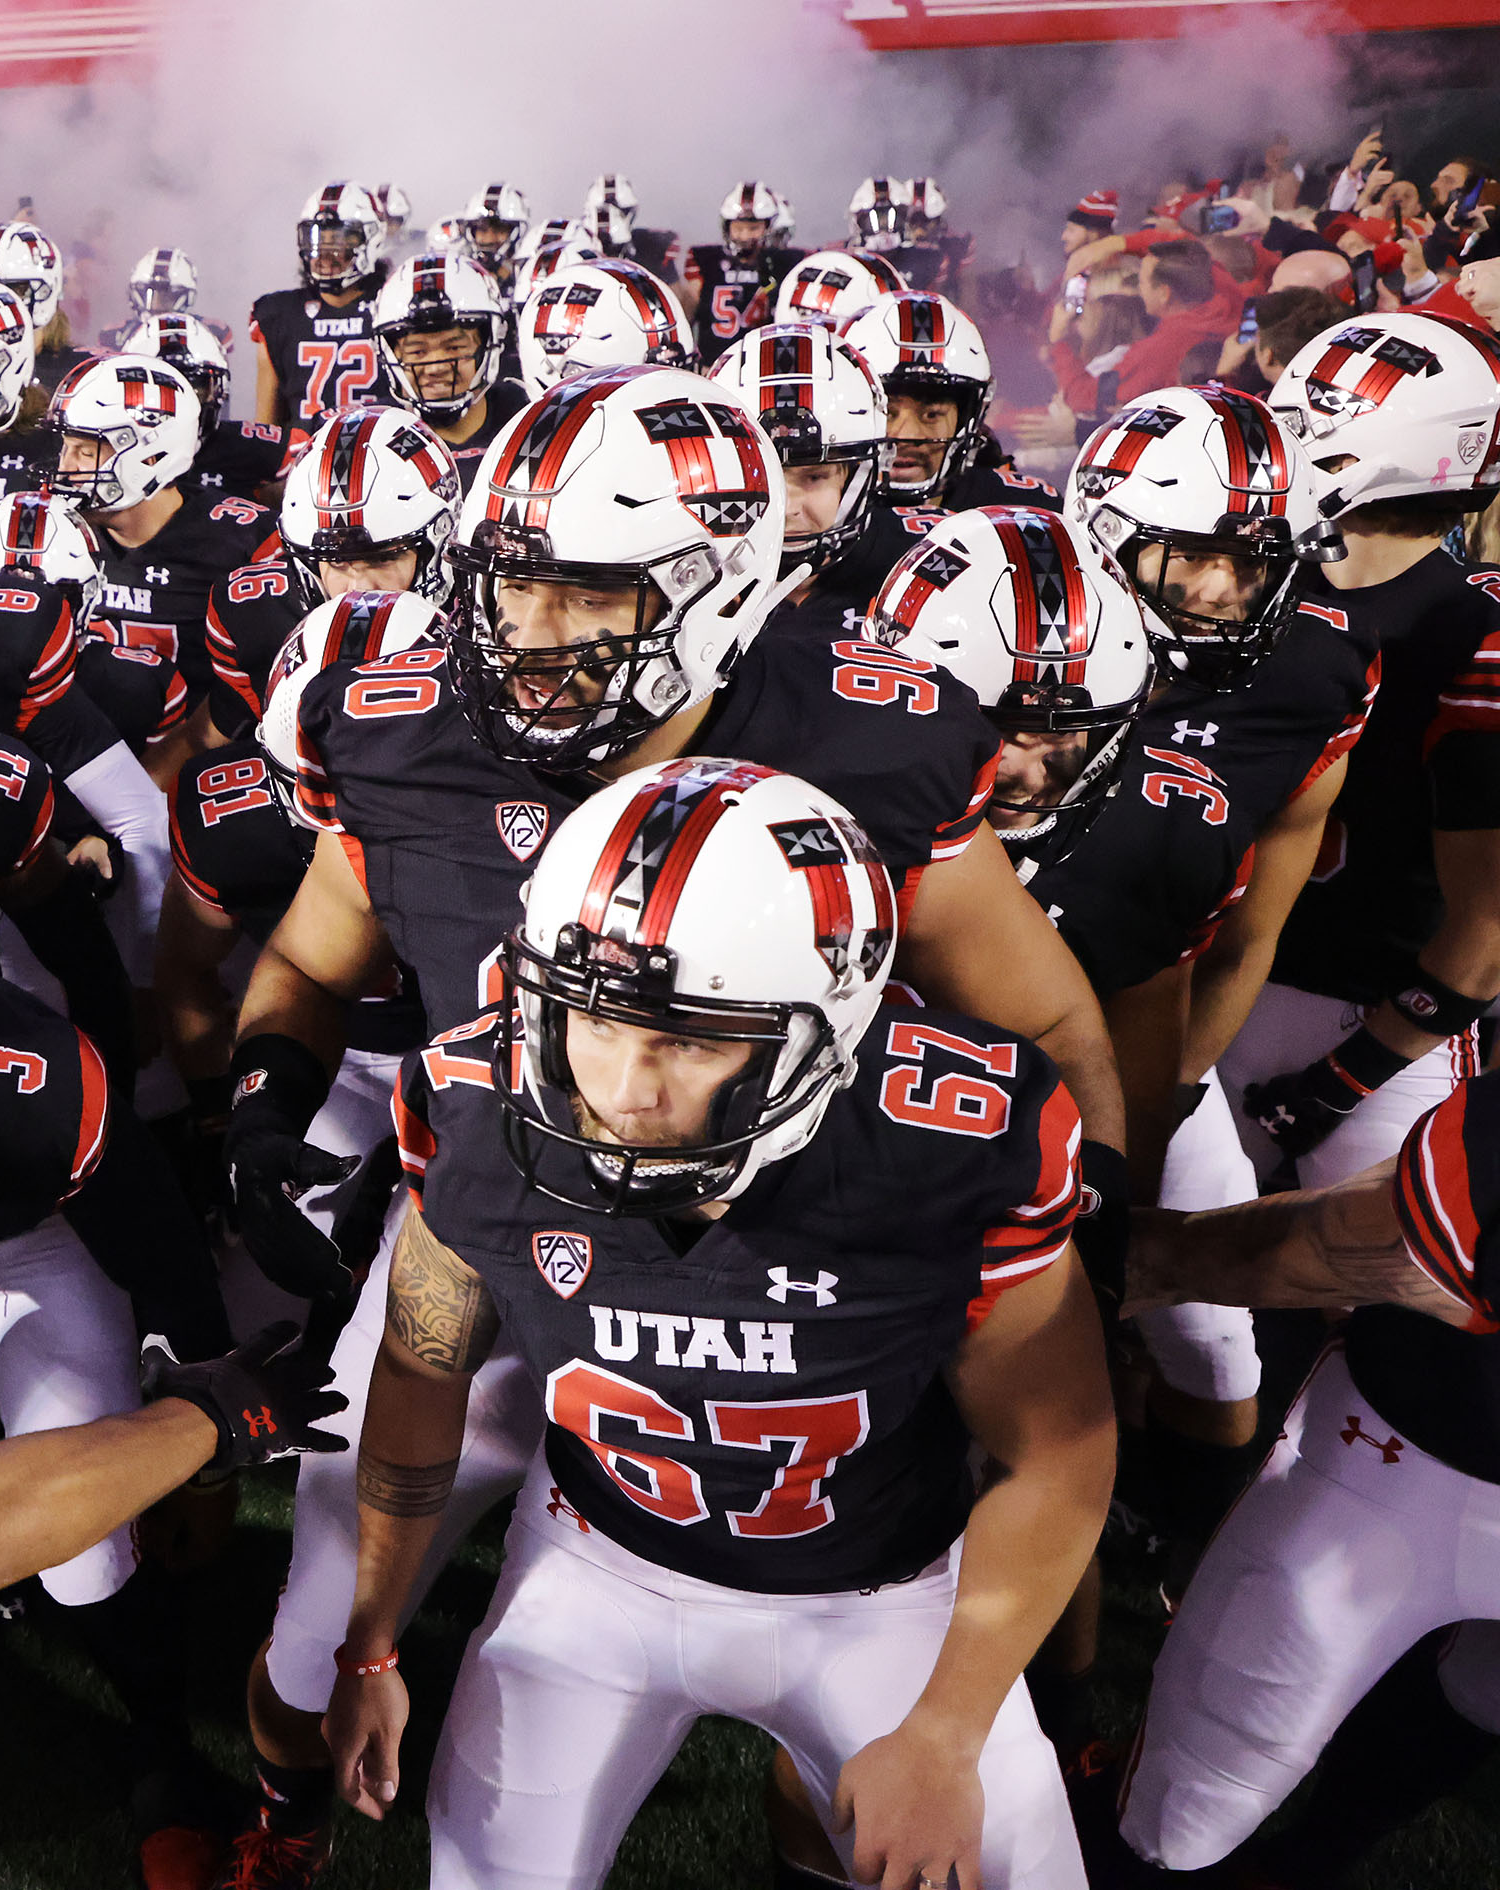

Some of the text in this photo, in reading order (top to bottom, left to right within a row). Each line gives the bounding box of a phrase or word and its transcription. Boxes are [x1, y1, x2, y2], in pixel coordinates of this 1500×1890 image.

[313, 317, 364, 337] UTAH
[298, 340, 378, 419] 72
[102, 584, 152, 614] TAH
[500, 803, 545, 836] PAC
[511, 828, 534, 848] 12
[537, 1235, 587, 1272] PAC
[551, 1261, 577, 1284] 12
[589, 1304, 798, 1374] UTAH
[546, 1357, 870, 1539] 67
